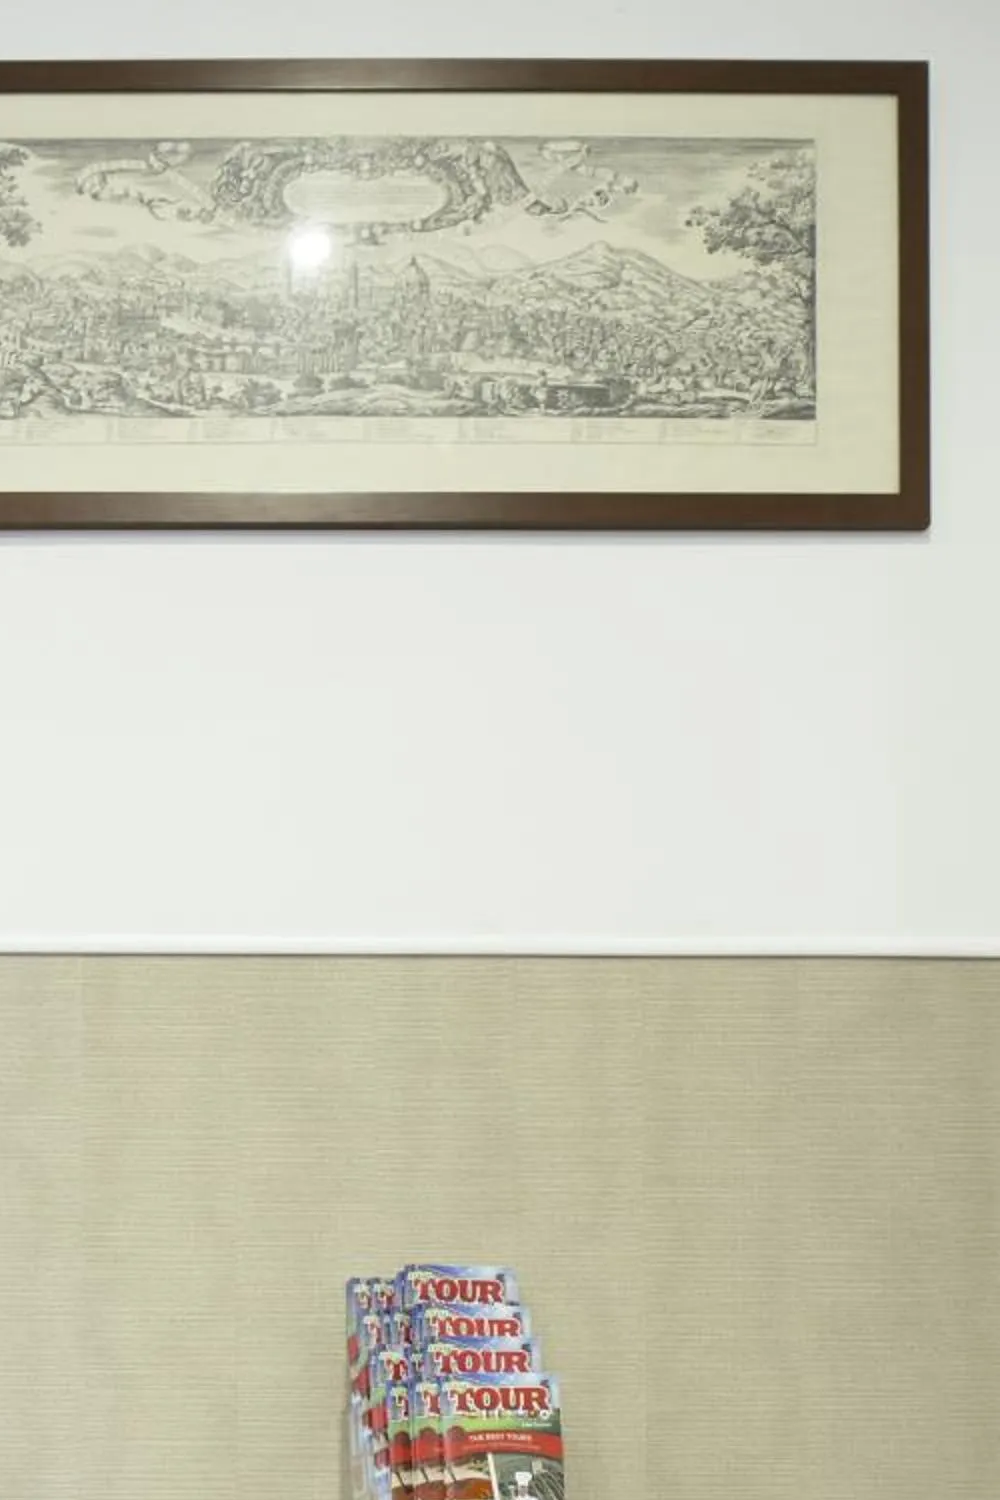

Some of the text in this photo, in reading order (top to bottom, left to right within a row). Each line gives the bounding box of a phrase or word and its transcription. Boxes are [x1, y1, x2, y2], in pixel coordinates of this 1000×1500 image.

[413, 1277, 504, 1304] TOUR
[431, 1315, 523, 1338] TOUR
[434, 1349, 530, 1374] TOUR
[449, 1385, 551, 1412] TOUR
